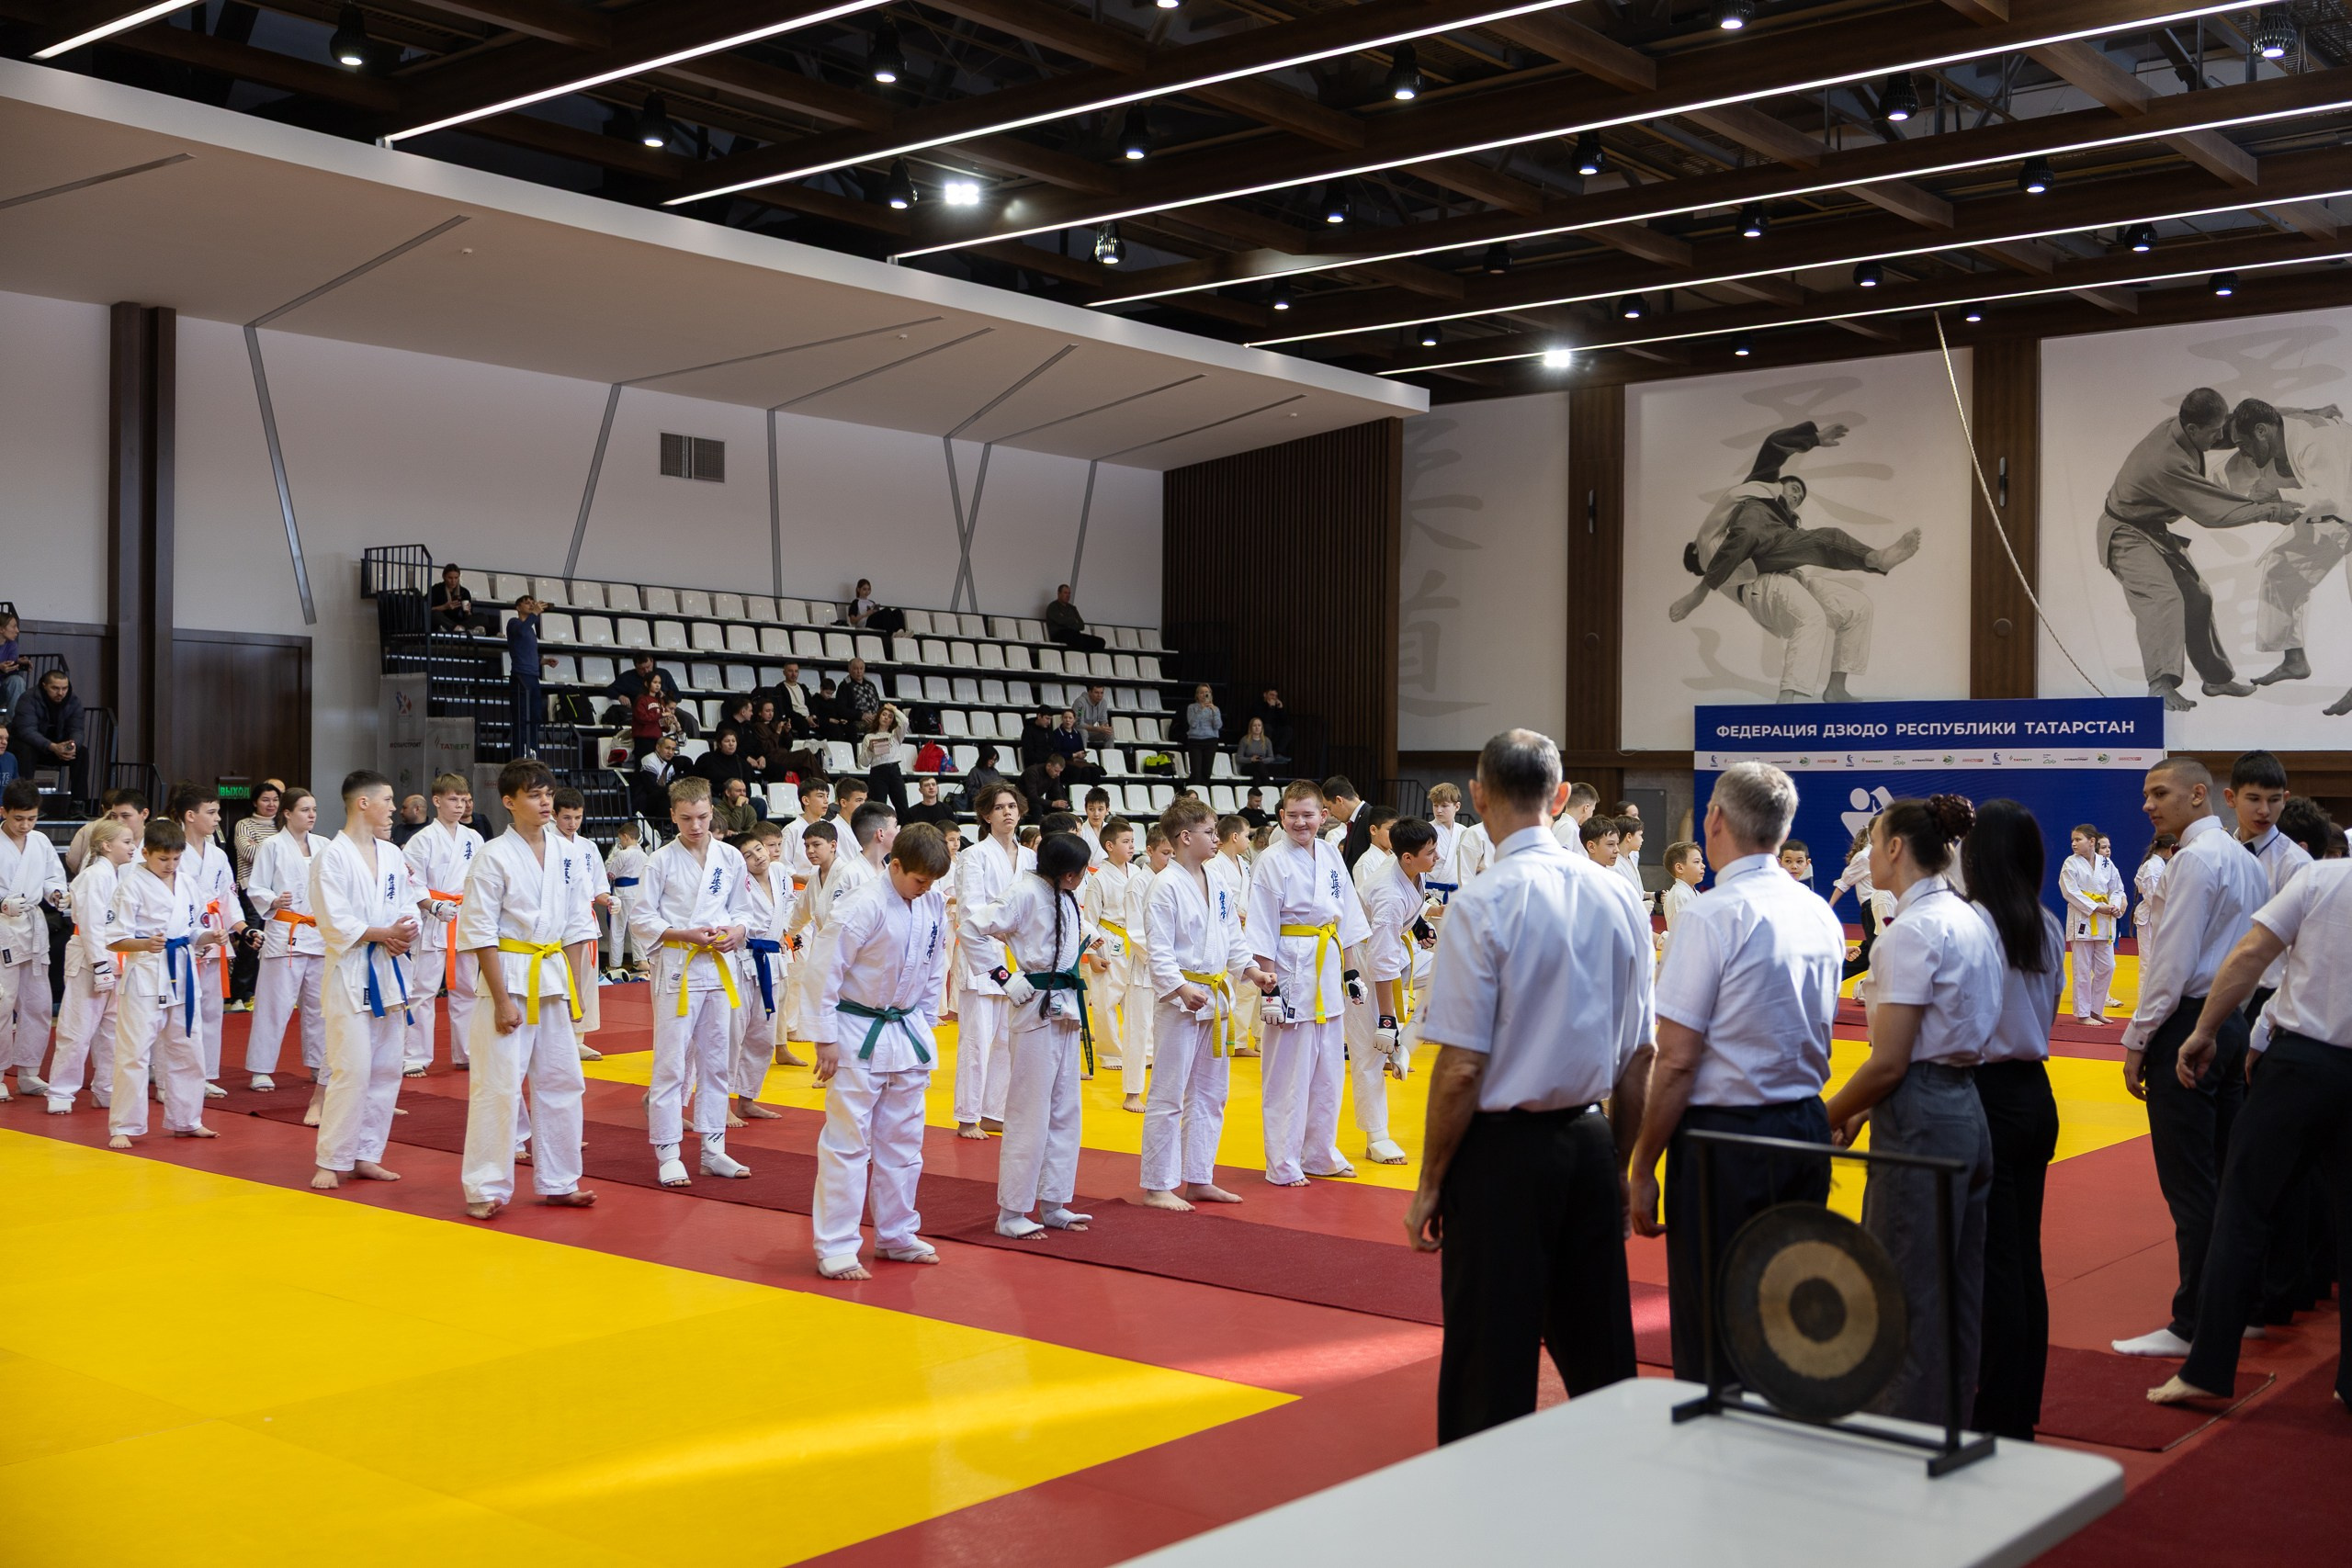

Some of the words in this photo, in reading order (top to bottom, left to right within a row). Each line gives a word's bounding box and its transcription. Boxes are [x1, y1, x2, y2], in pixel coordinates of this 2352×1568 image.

[1716, 725, 1817, 739] ФЕДЕРАЦИЯ
[1823, 723, 1888, 738] ДЗЮДО
[1895, 722, 2016, 736] РЕСПУБЛИКИ
[2024, 721, 2134, 734] ТАТАРСТАН
[220, 786, 250, 798] ВЫХОД
